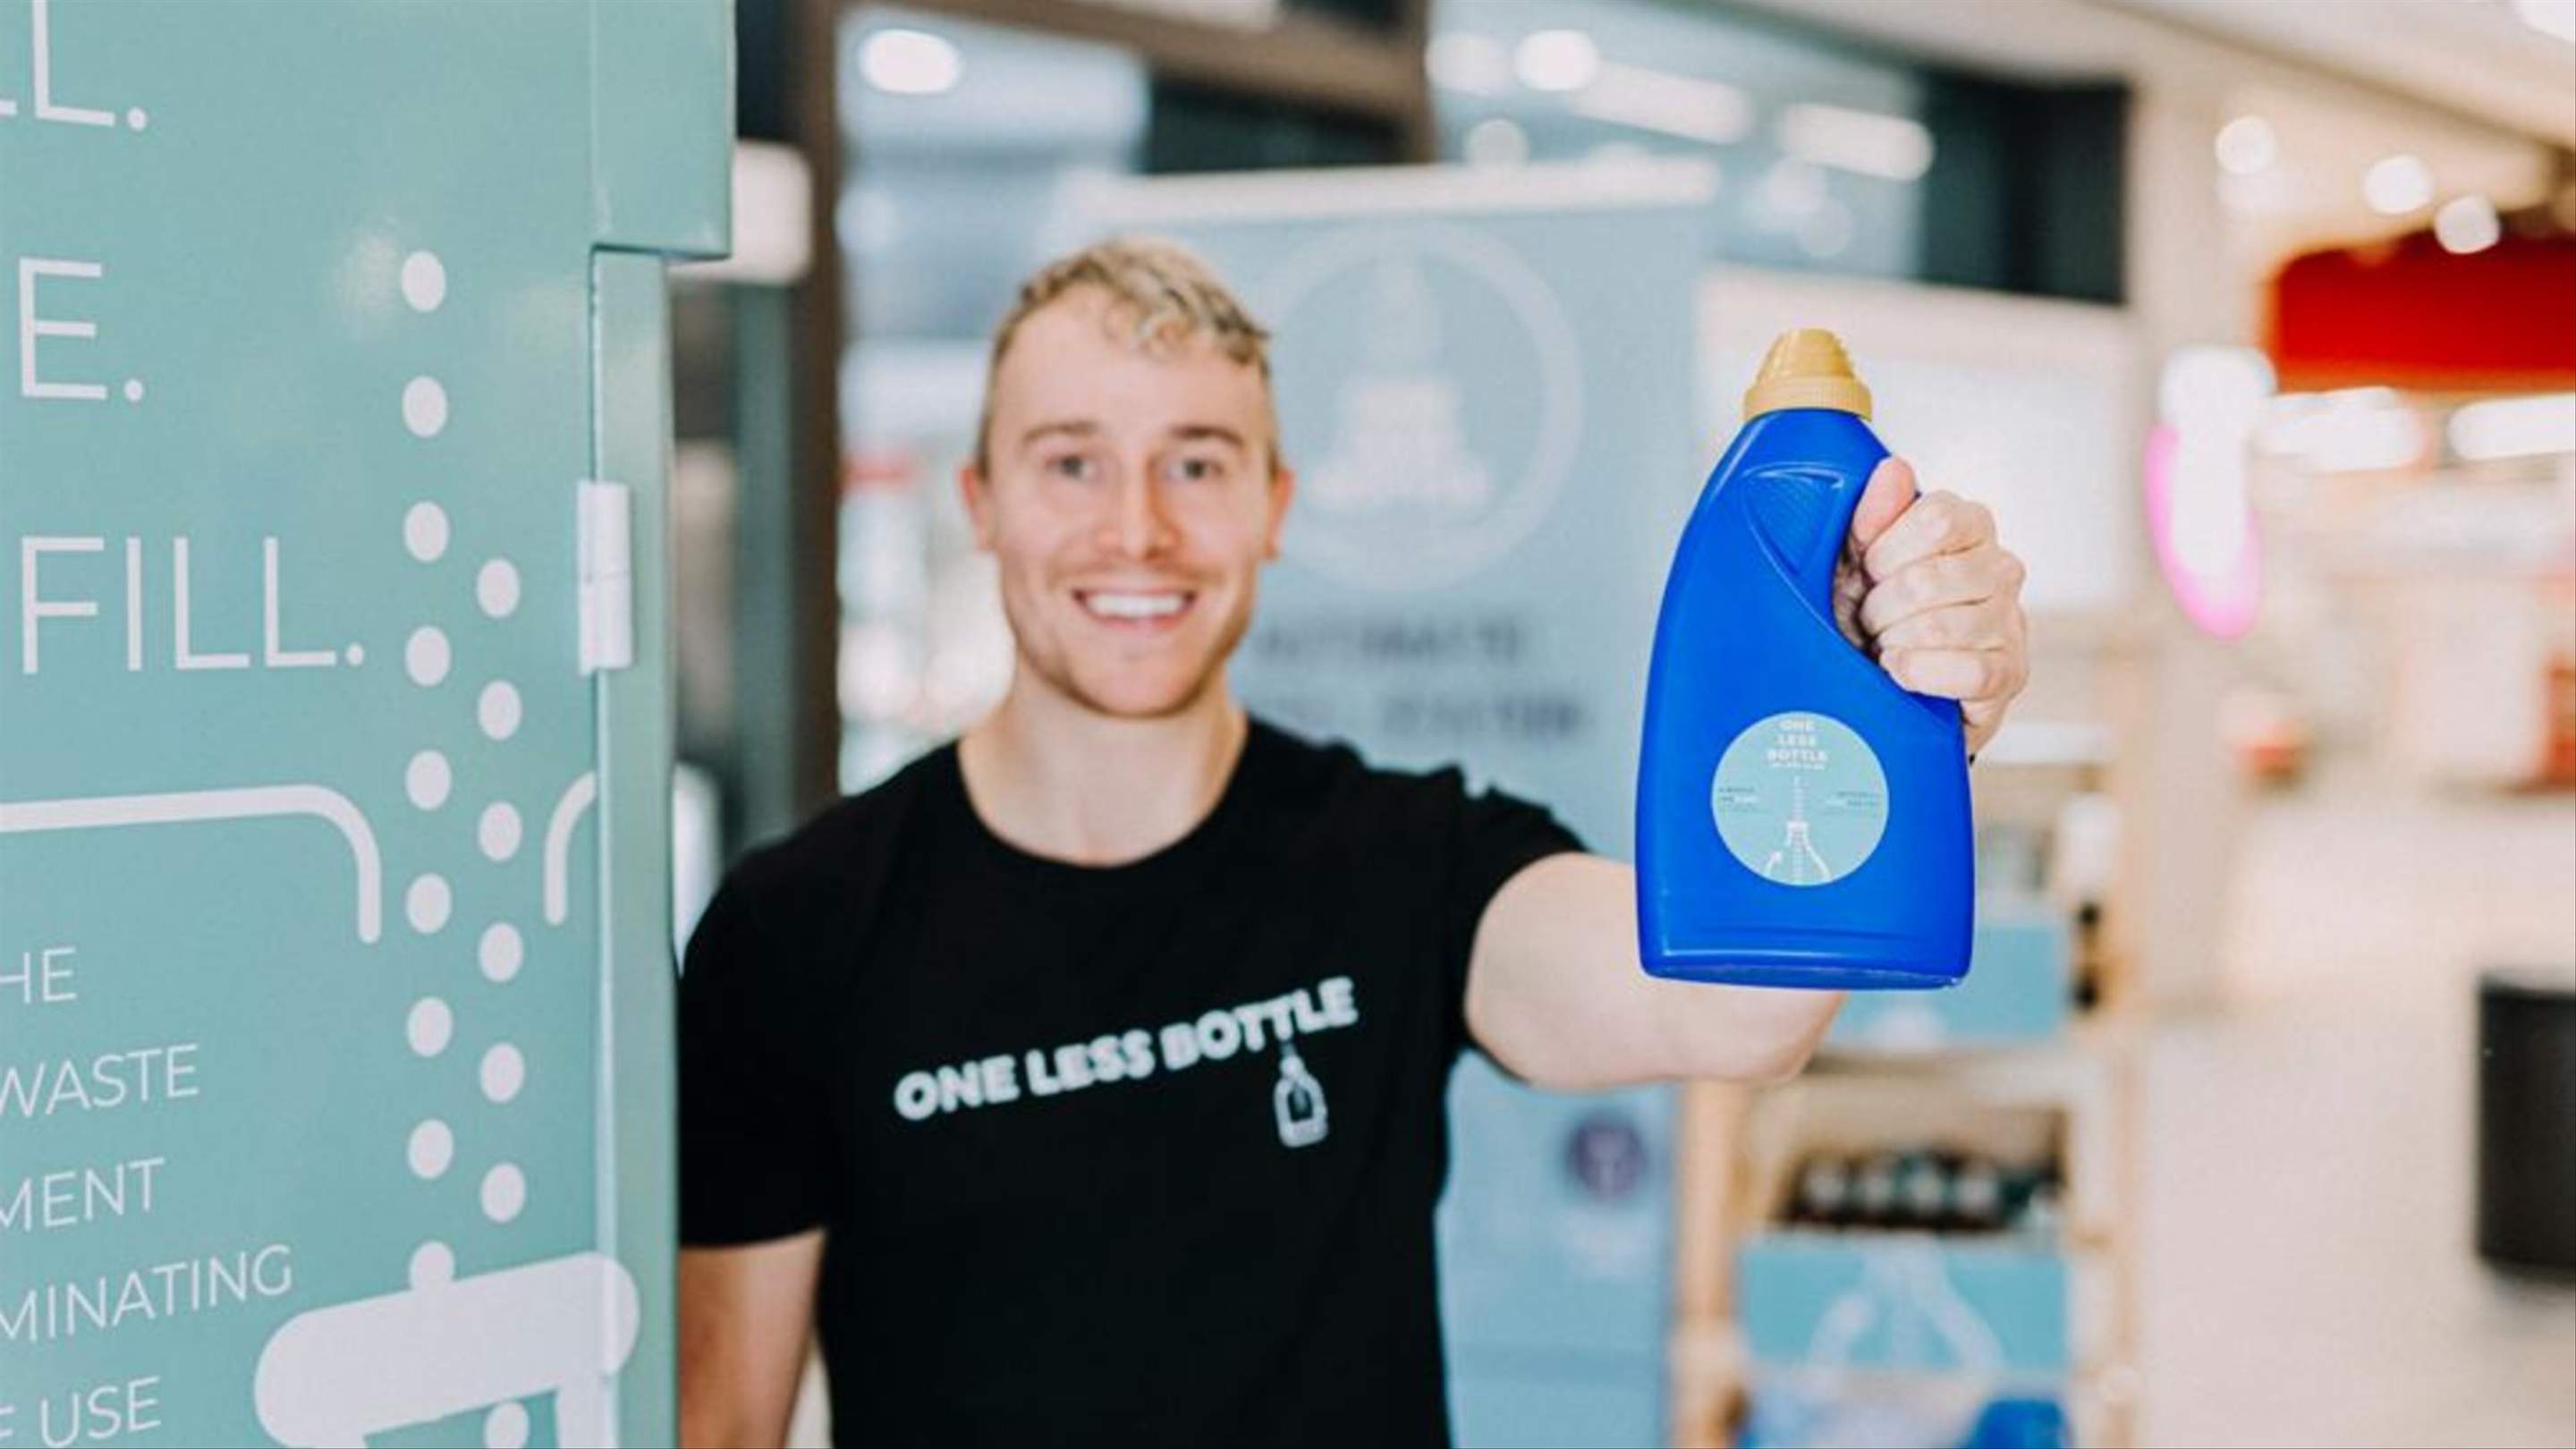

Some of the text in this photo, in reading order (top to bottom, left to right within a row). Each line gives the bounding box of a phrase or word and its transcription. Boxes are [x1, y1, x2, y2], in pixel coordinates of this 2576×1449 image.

[22, 536, 364, 674] FILL.
[0, 1043, 199, 1117] WASTE
[894, 976, 1359, 1121] ONE LESS BOTTLE
[40, 1376, 162, 1449] USE
